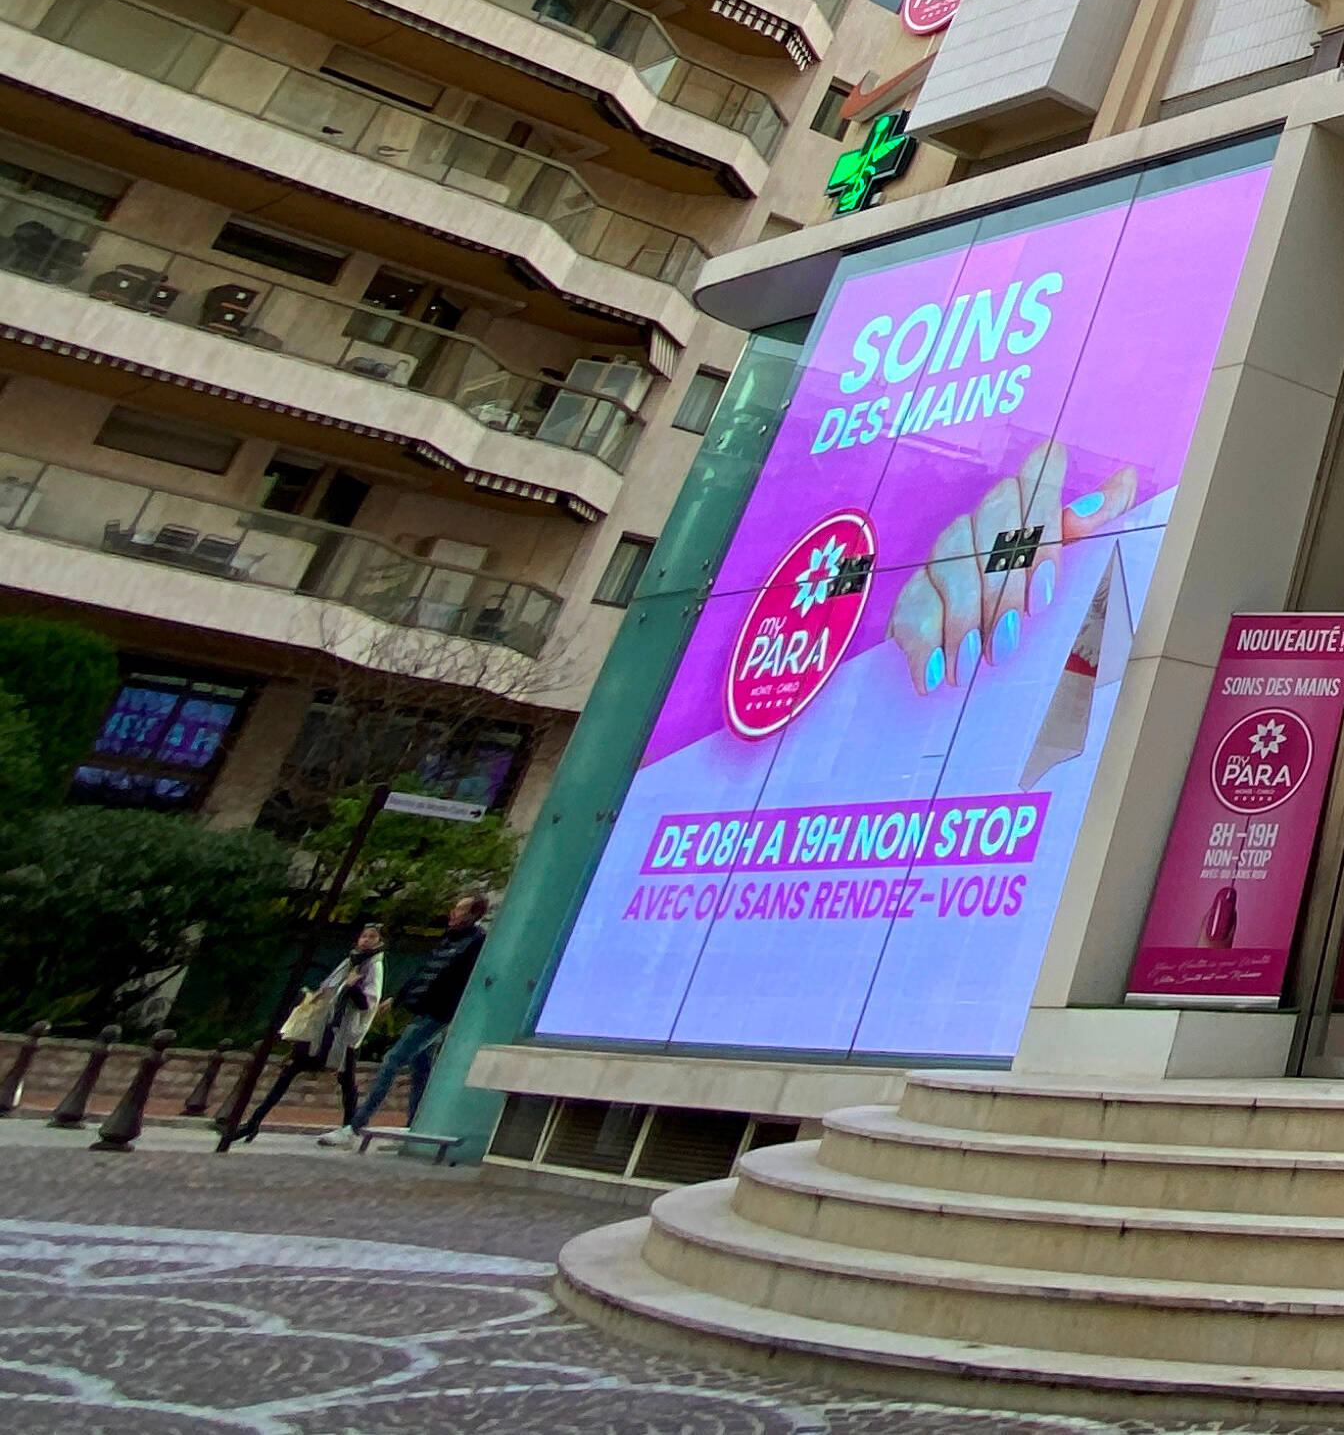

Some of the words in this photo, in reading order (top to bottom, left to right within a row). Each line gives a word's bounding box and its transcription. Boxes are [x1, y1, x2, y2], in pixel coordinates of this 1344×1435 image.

[839, 272, 1063, 394] SOINS
[810, 397, 890, 455] DES
[888, 364, 1031, 438] MAINS
[739, 627, 829, 681] PARA
[1222, 676, 1264, 695] SOINS
[1265, 677, 1293, 696] DES
[1294, 677, 1341, 696] MAINS
[1222, 764, 1291, 786] PARA
[650, 825, 697, 868] DE
[696, 820, 761, 867] 08H
[757, 818, 786, 864] A
[789, 814, 851, 863] 19H
[848, 811, 936, 861] NON
[934, 805, 1038, 859] STOP
[1203, 849, 1272, 867] NON-STOP
[622, 883, 696, 921] AVEC
[698, 883, 738, 921] OU
[734, 880, 810, 920] SANS
[808, 874, 1028, 920] RENDEZ-VOUS
